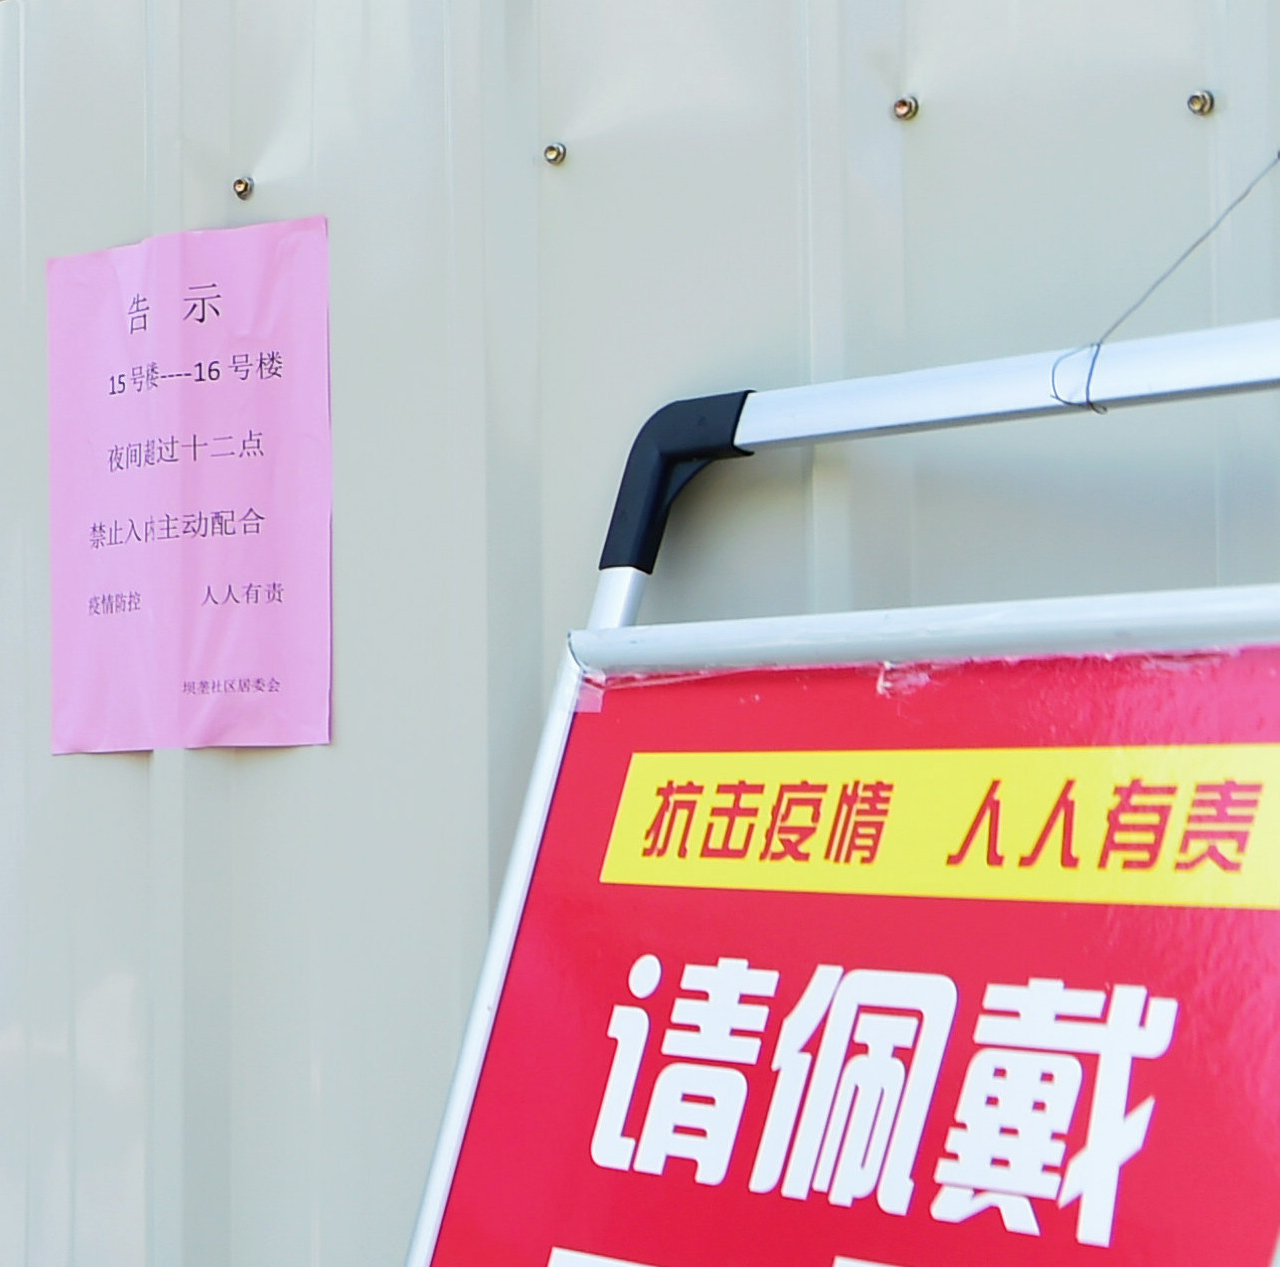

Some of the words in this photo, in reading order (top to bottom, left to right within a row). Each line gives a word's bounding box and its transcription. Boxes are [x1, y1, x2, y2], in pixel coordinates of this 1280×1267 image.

[107, 429, 266, 473] 夜间超过十二点
[88, 590, 142, 617] 疫情防控
[200, 581, 285, 606] 人人有责
[641, 779, 895, 865] 抗击疫情
[946, 778, 1265, 874] 人人有责
[589, 953, 1180, 1248] 请佩戴
